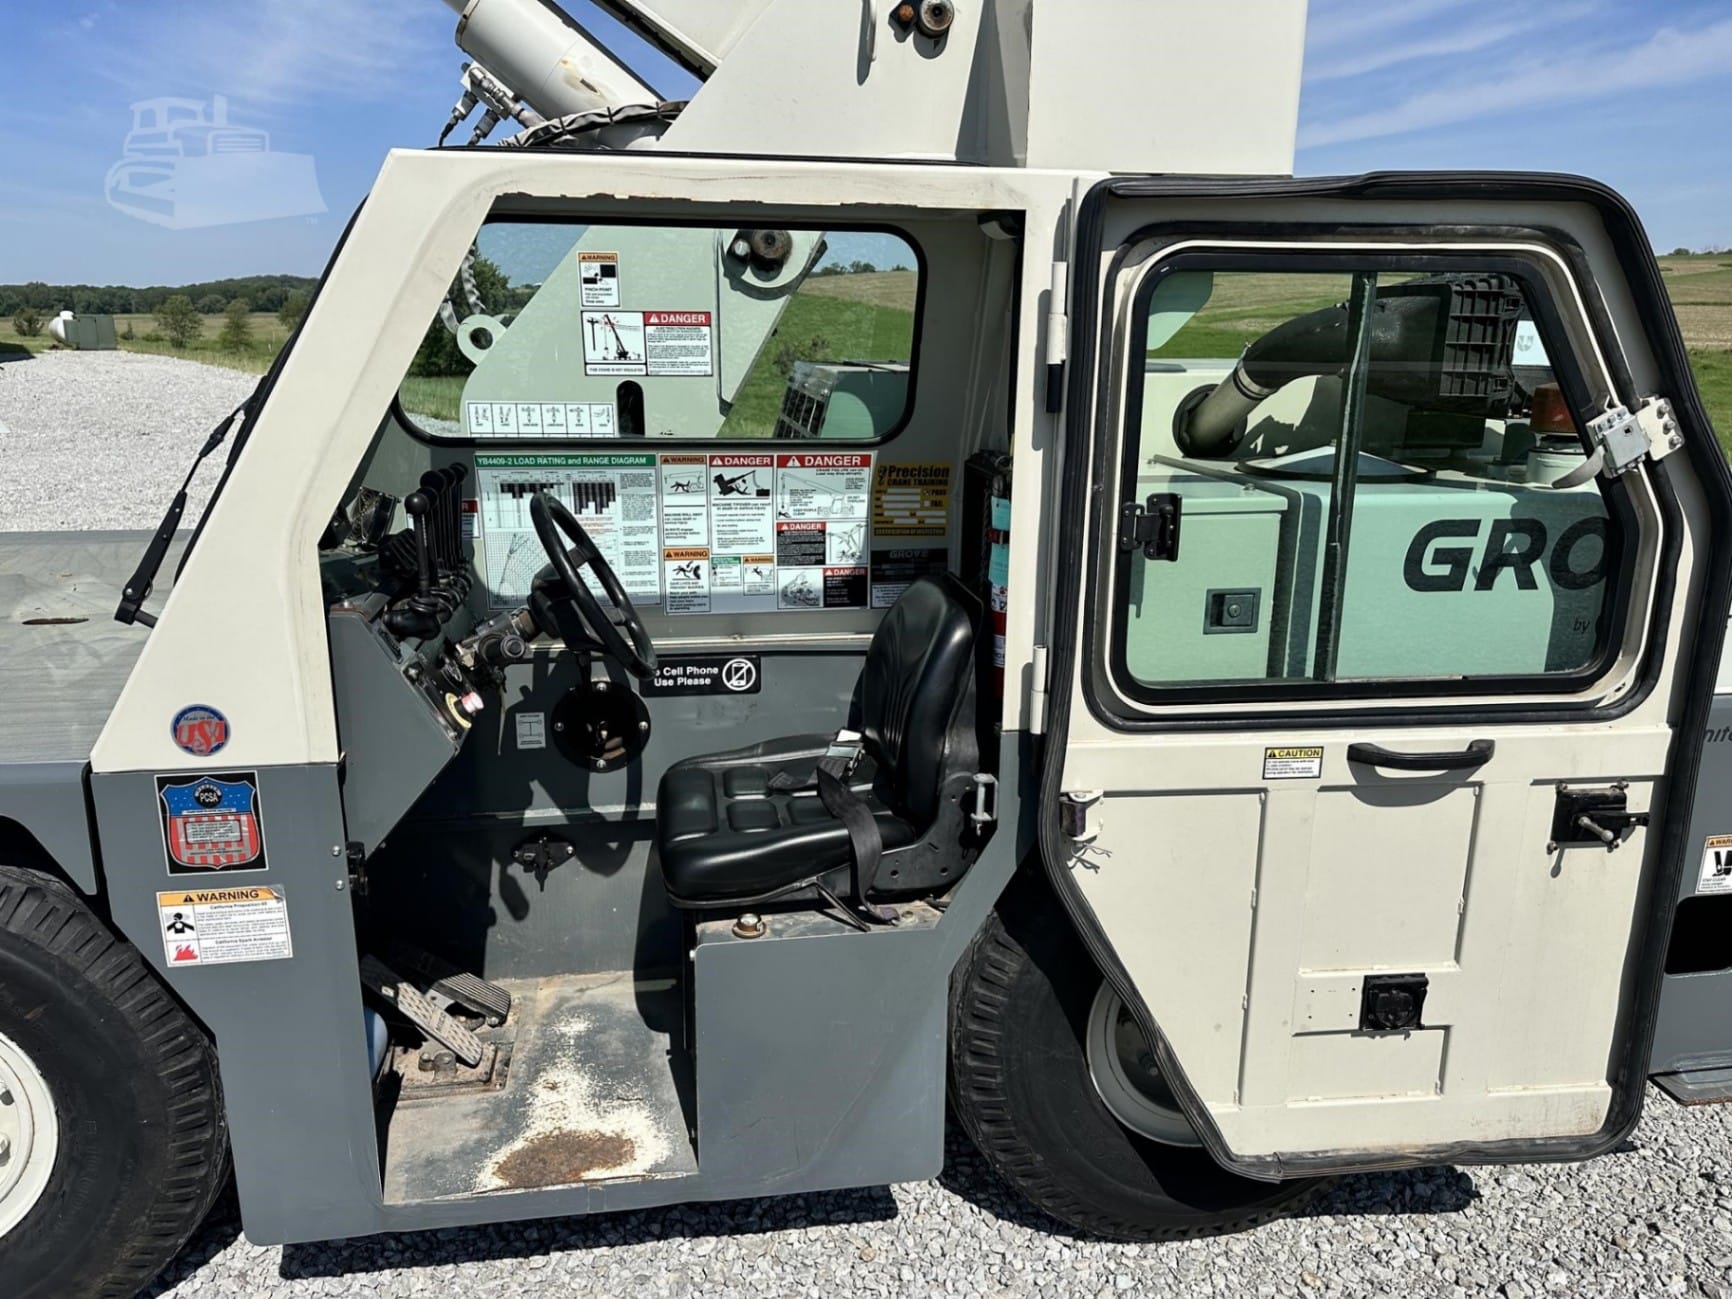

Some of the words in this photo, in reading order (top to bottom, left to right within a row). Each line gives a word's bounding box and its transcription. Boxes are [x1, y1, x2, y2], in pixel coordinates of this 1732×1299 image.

[661, 314, 705, 323] DANGER
[514, 457, 535, 465] LOAD
[538, 457, 566, 465] RATING
[725, 457, 771, 465] DANGER
[805, 456, 861, 466] DANGER
[888, 464, 950, 478] Precision
[1573, 618, 1590, 633] by
[663, 667, 683, 676] Cell
[687, 666, 719, 674] Phone
[654, 678, 674, 686] Use
[677, 677, 711, 686] Please
[200, 792, 218, 802] PCSA
[197, 889, 259, 902] WARNING
